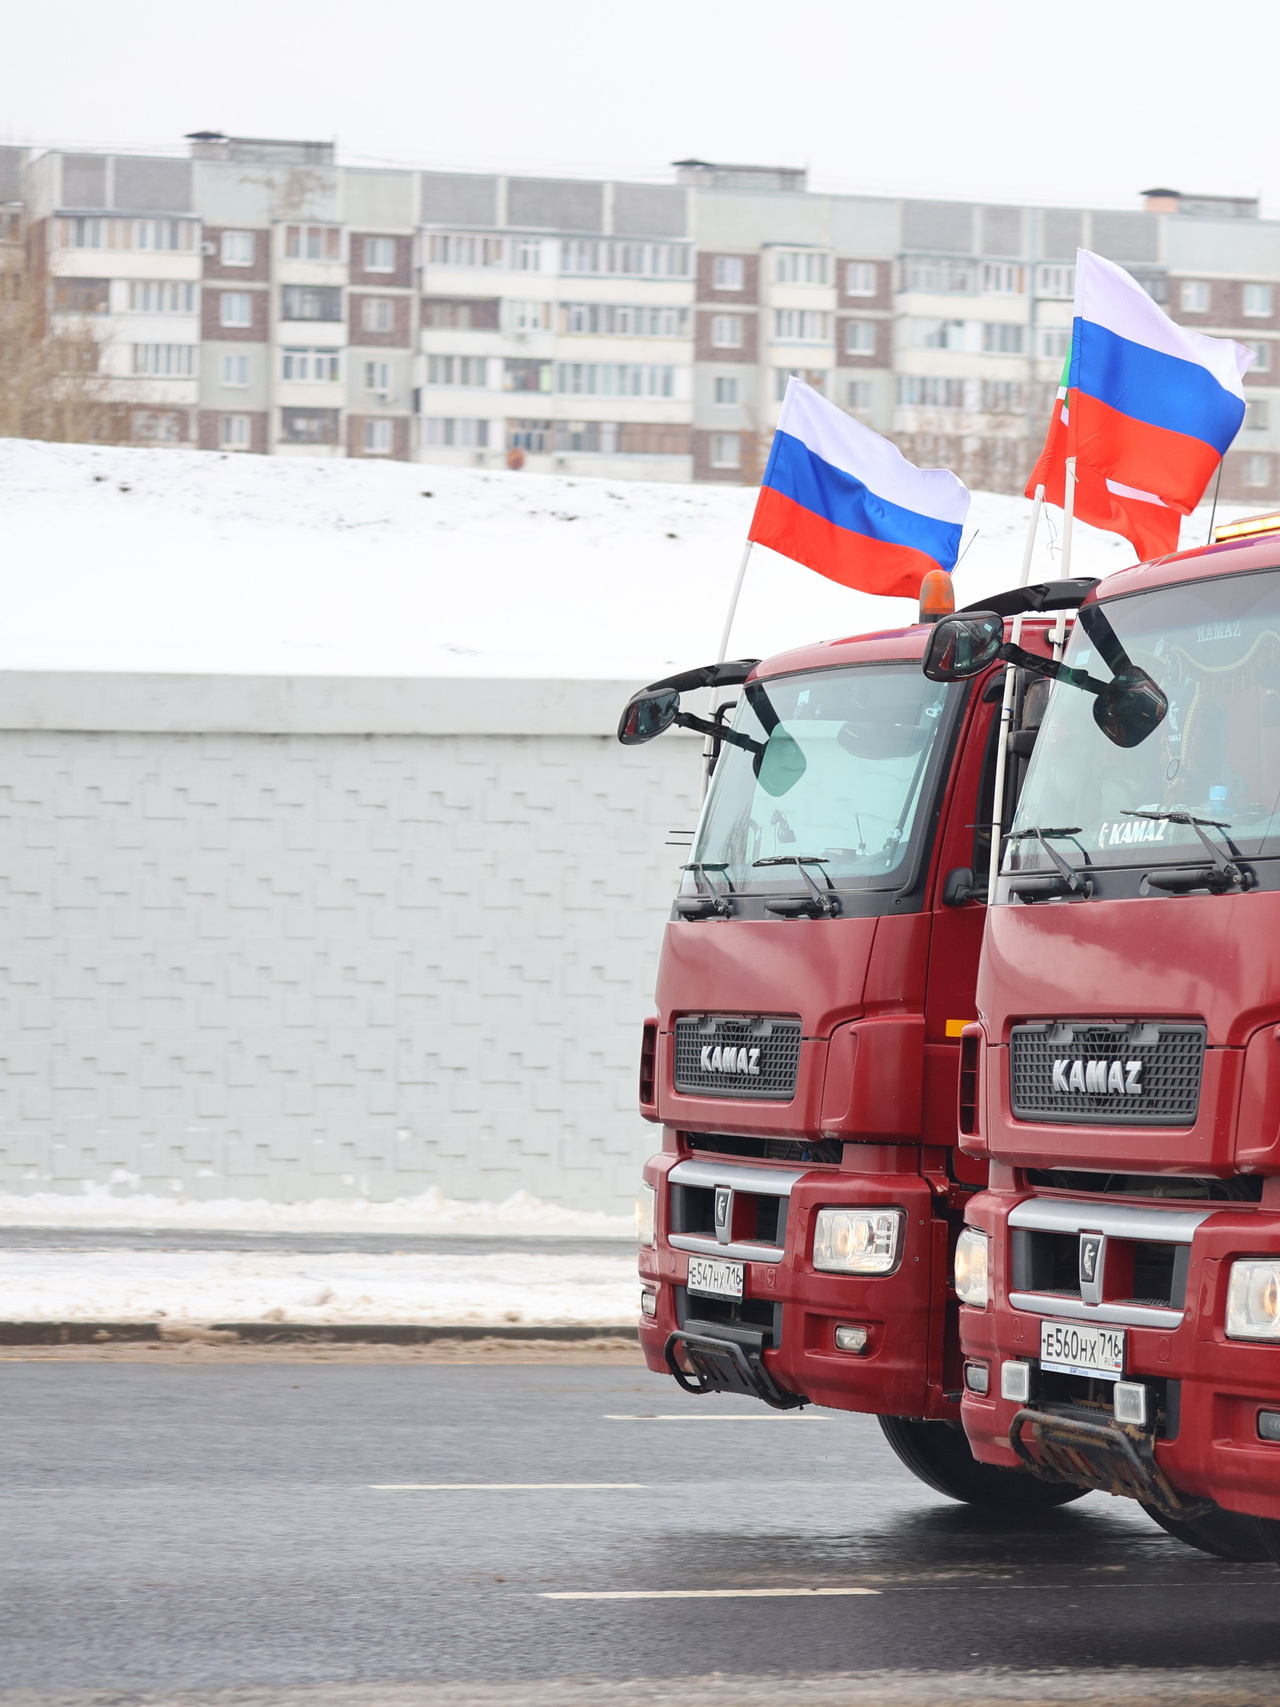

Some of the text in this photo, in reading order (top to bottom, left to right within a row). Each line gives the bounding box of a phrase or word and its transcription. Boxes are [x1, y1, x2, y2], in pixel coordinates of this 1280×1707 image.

[1196, 620, 1241, 642] KAMAZ
[1109, 818, 1169, 845] KAMAZ
[701, 1046, 760, 1074] KAMAZ
[1053, 1060, 1142, 1093] KAMAZ
[726, 1266, 740, 1286] 716
[1100, 1333, 1120, 1358] 716
